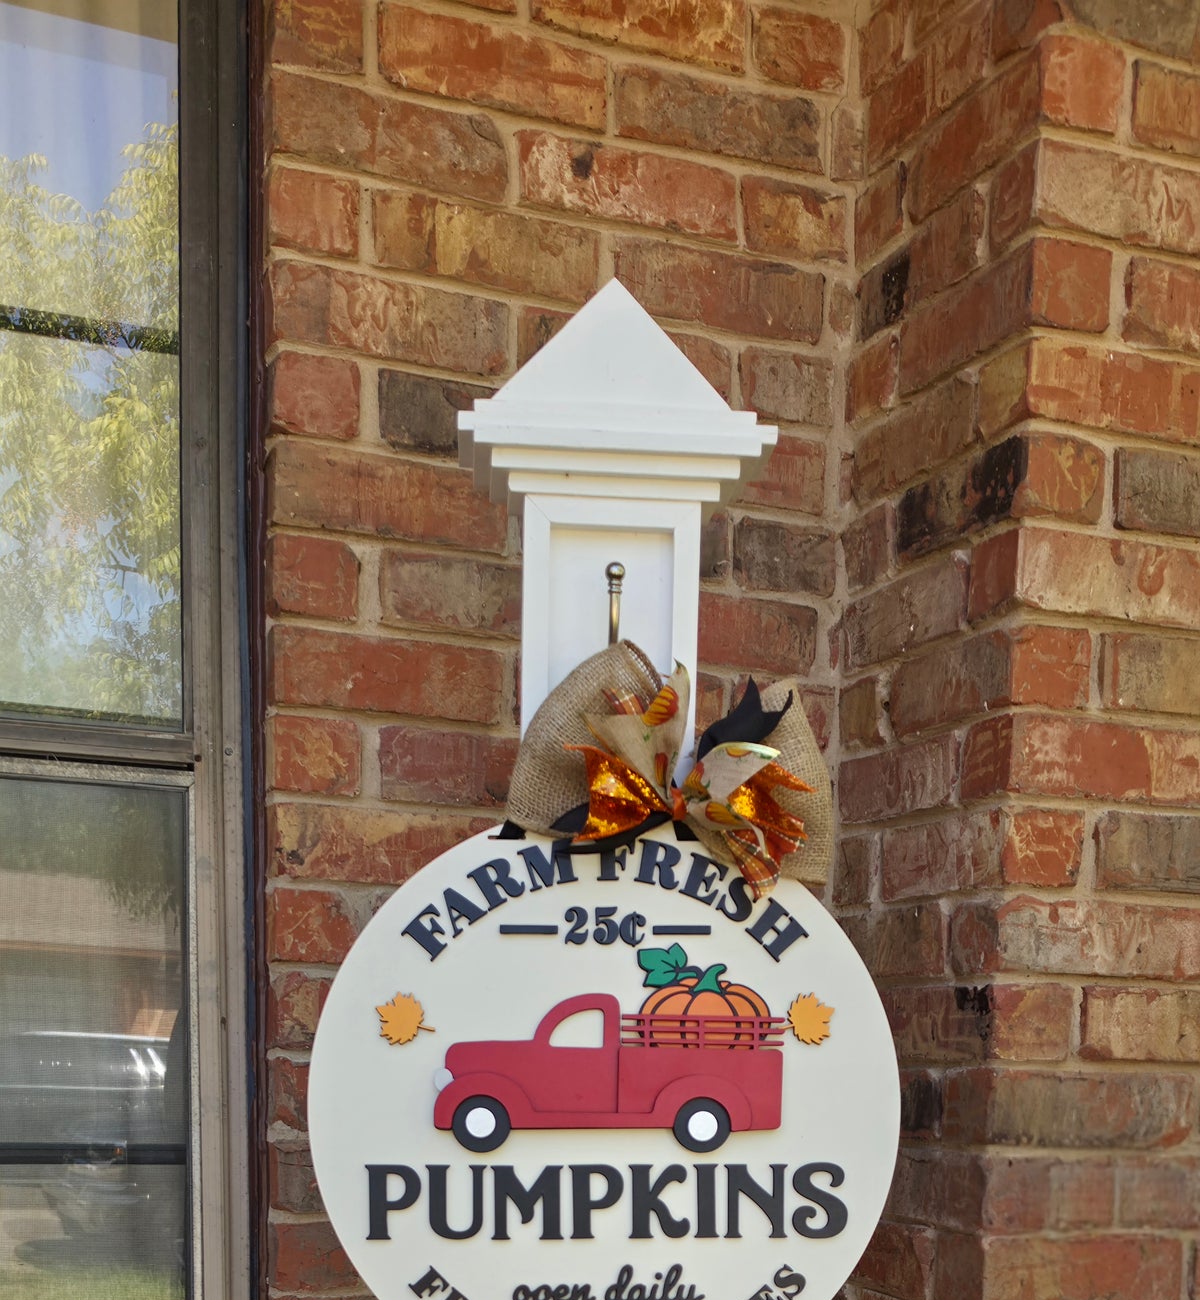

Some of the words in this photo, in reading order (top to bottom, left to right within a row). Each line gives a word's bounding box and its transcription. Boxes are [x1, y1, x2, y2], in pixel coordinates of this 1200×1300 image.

[400, 841, 579, 963] FARM
[596, 839, 810, 963] FRESH
[564, 906, 647, 948] 25¢
[365, 1161, 849, 1242] PUMPKINS
